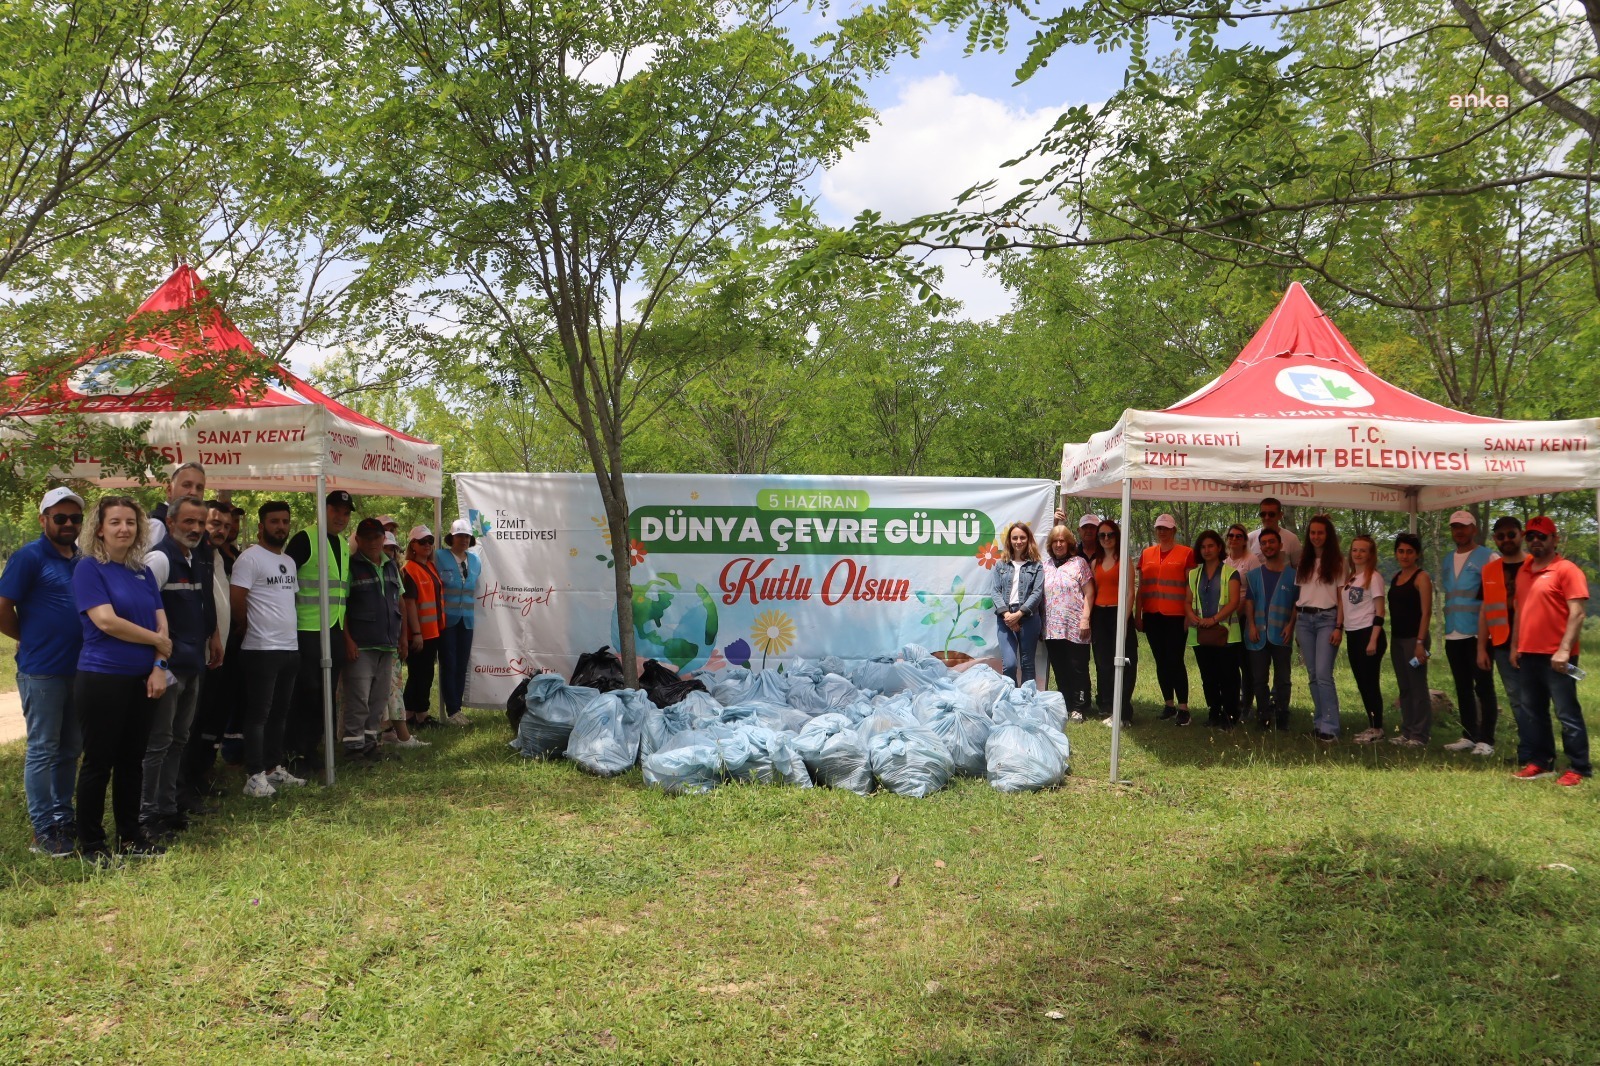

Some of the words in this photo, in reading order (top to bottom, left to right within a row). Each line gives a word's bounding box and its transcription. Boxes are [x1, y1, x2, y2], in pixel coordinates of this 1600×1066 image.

[197, 430, 252, 444] SANAT
[255, 425, 306, 443] KENTİ
[1144, 432, 1188, 445] SPOR
[1192, 431, 1240, 446] KENTİ
[1347, 426, 1385, 443] T.C.
[385, 435, 396, 452] T.C.
[1484, 437, 1535, 452] SANAT
[1540, 436, 1587, 452] KENTİ
[198, 449, 242, 465] İZMİT
[361, 448, 381, 472] İZMİT
[381, 456, 415, 481] BELEDİYESİ
[1144, 448, 1188, 467] İZMİT
[1264, 444, 1327, 469] İZMİT
[1334, 445, 1470, 471] BELEDİYESİ
[1484, 456, 1526, 472] İZMİT
[769, 494, 778, 508] 5
[784, 492, 858, 510] HAZİRAN
[496, 509, 508, 517] T.C.
[496, 517, 526, 529] İZMİT
[640, 508, 764, 543] DÜNYA
[770, 516, 878, 552] ÇEVRE
[884, 510, 981, 545] GÜNÜ
[496, 528, 557, 541] BELEDİYESİ
[718, 557, 812, 606] Kutlu
[820, 558, 910, 607] Olsun
[474, 663, 511, 674] Gülümse
